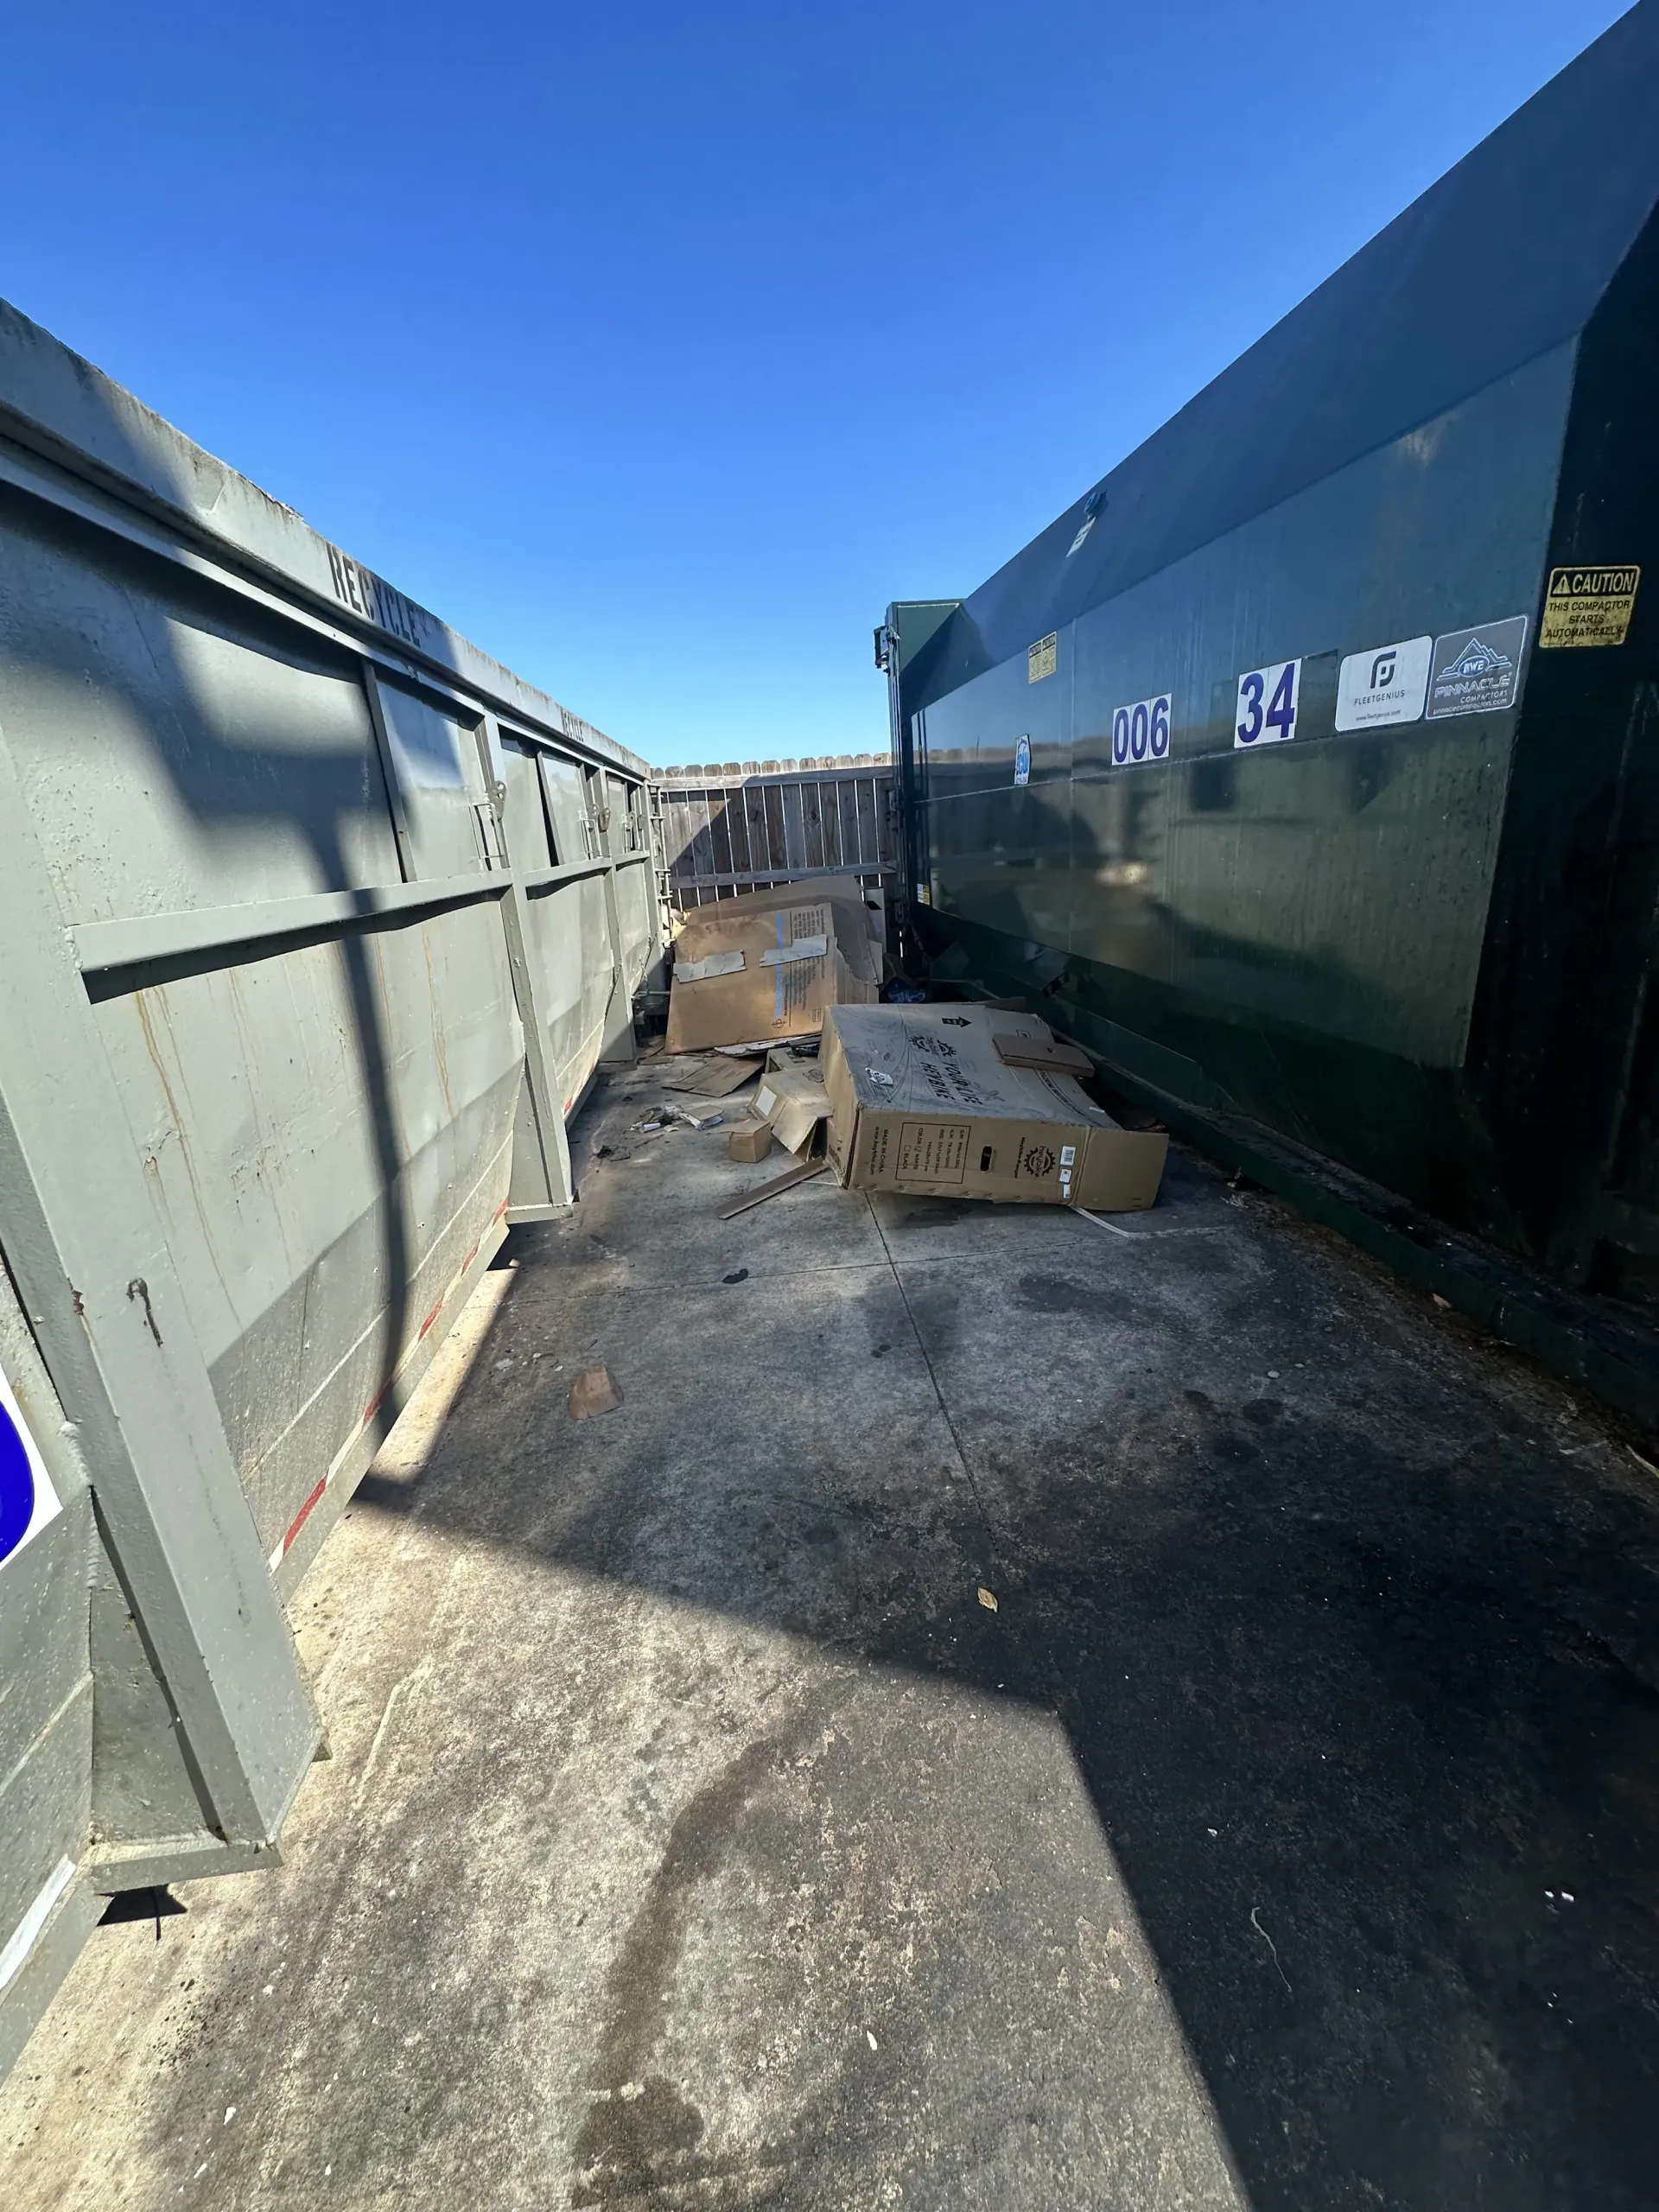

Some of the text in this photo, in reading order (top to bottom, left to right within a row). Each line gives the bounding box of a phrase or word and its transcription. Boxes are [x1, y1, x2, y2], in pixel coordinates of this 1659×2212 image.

[1572, 572, 1635, 594] CAUTION
[326, 542, 421, 648] RECYCLE
[1548, 601, 1630, 612] THIS COMPACTOR
[1568, 613, 1605, 624] STARTS
[1545, 626, 1624, 638] AUTOMATICALLY
[1433, 674, 1511, 698] PINNACLE
[1460, 690, 1508, 704] COMPACTORS
[1237, 662, 1295, 743] 34
[1354, 690, 1406, 706] FLEETGENIUS
[1114, 697, 1169, 763] 006
[919, 1061, 956, 1100] HEYBIKE
